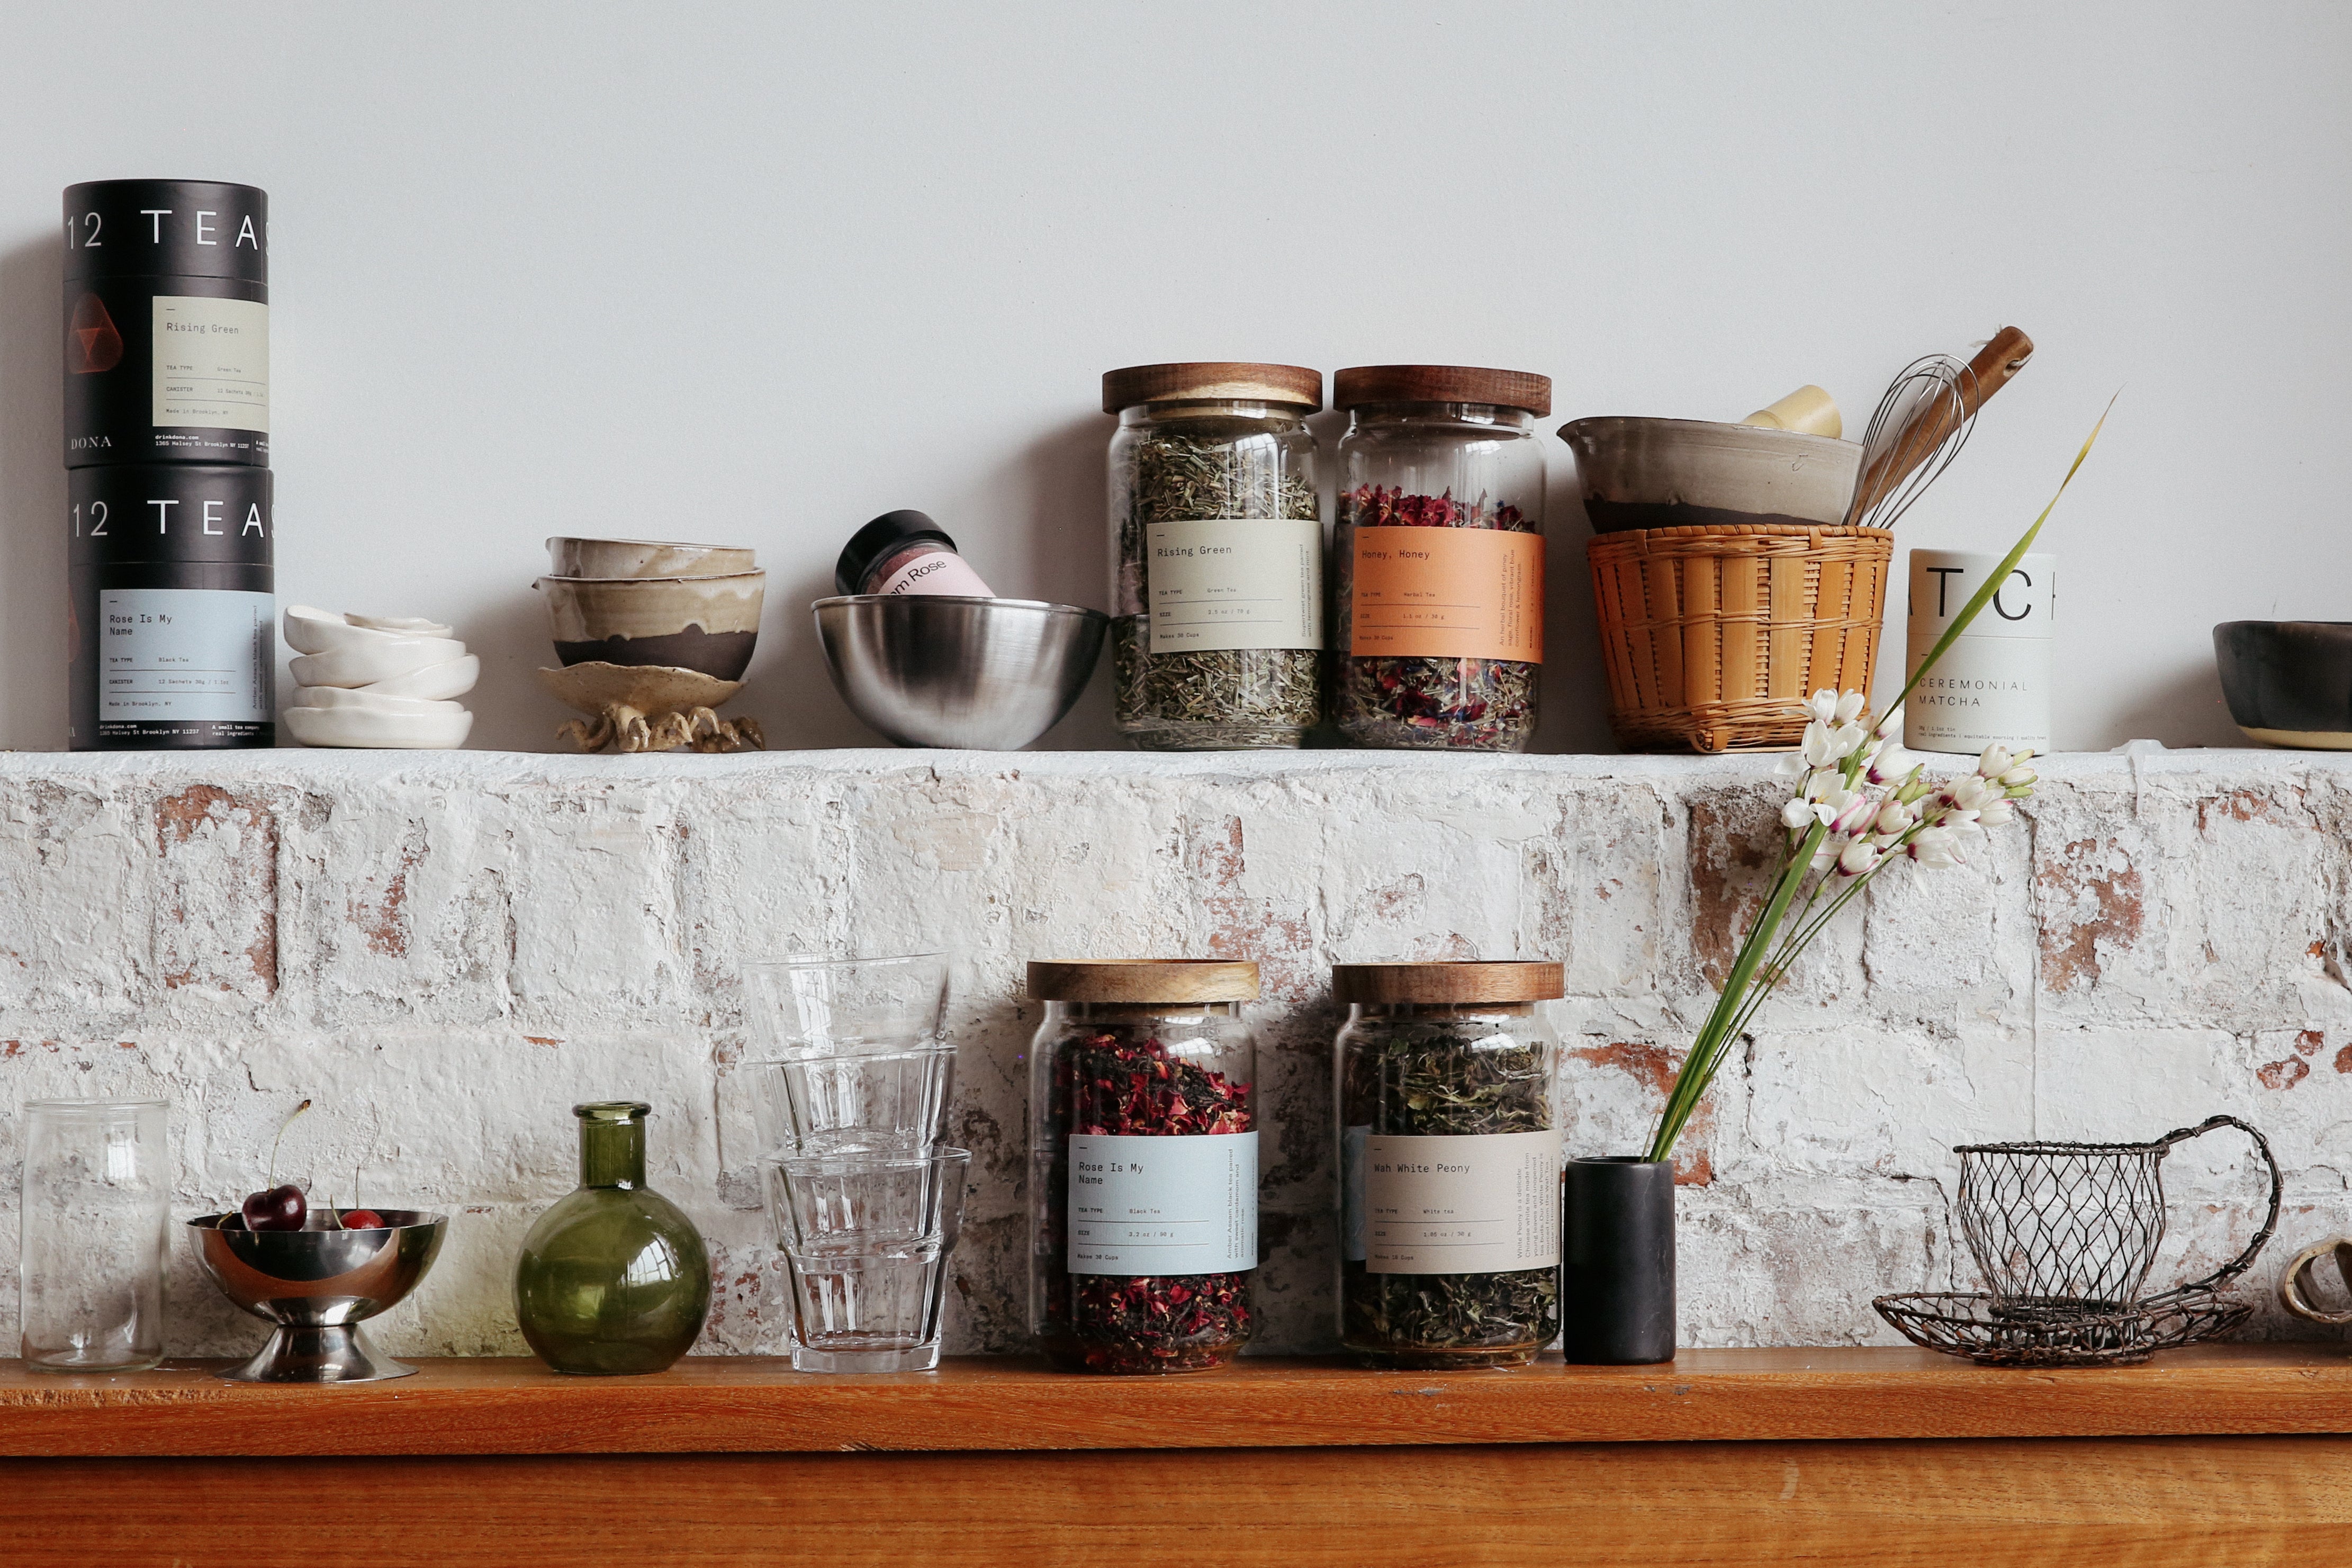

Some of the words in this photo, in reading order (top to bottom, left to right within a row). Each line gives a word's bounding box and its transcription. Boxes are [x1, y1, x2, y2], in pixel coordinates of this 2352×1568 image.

[67, 212, 102, 249] 12
[166, 322, 205, 335] Rising
[211, 323, 239, 335] Green
[71, 436, 112, 449] DONA
[73, 501, 108, 537] 12
[1157, 547, 1194, 557] Rising
[1200, 546, 1232, 555] Green
[1362, 550, 1392, 561] Honey,
[1399, 549, 1430, 560] Honey
[890, 579, 909, 594] m
[907, 560, 947, 582] Rose
[110, 615, 133, 624] Rose
[140, 614, 152, 624] Is
[159, 614, 173, 625] My
[110, 627, 133, 635] Name
[1500, 636, 1504, 645] An
[1920, 678, 2027, 691] CEREMONIAL
[1919, 695, 1980, 707] MATCHA
[1078, 1161, 1103, 1172] Rose
[1111, 1163, 1123, 1172] Is
[1130, 1163, 1144, 1174] My
[1374, 1164, 1391, 1173] Wah
[1398, 1164, 1429, 1173] White
[1437, 1164, 1470, 1174] Peony
[1078, 1175, 1103, 1185] Name
